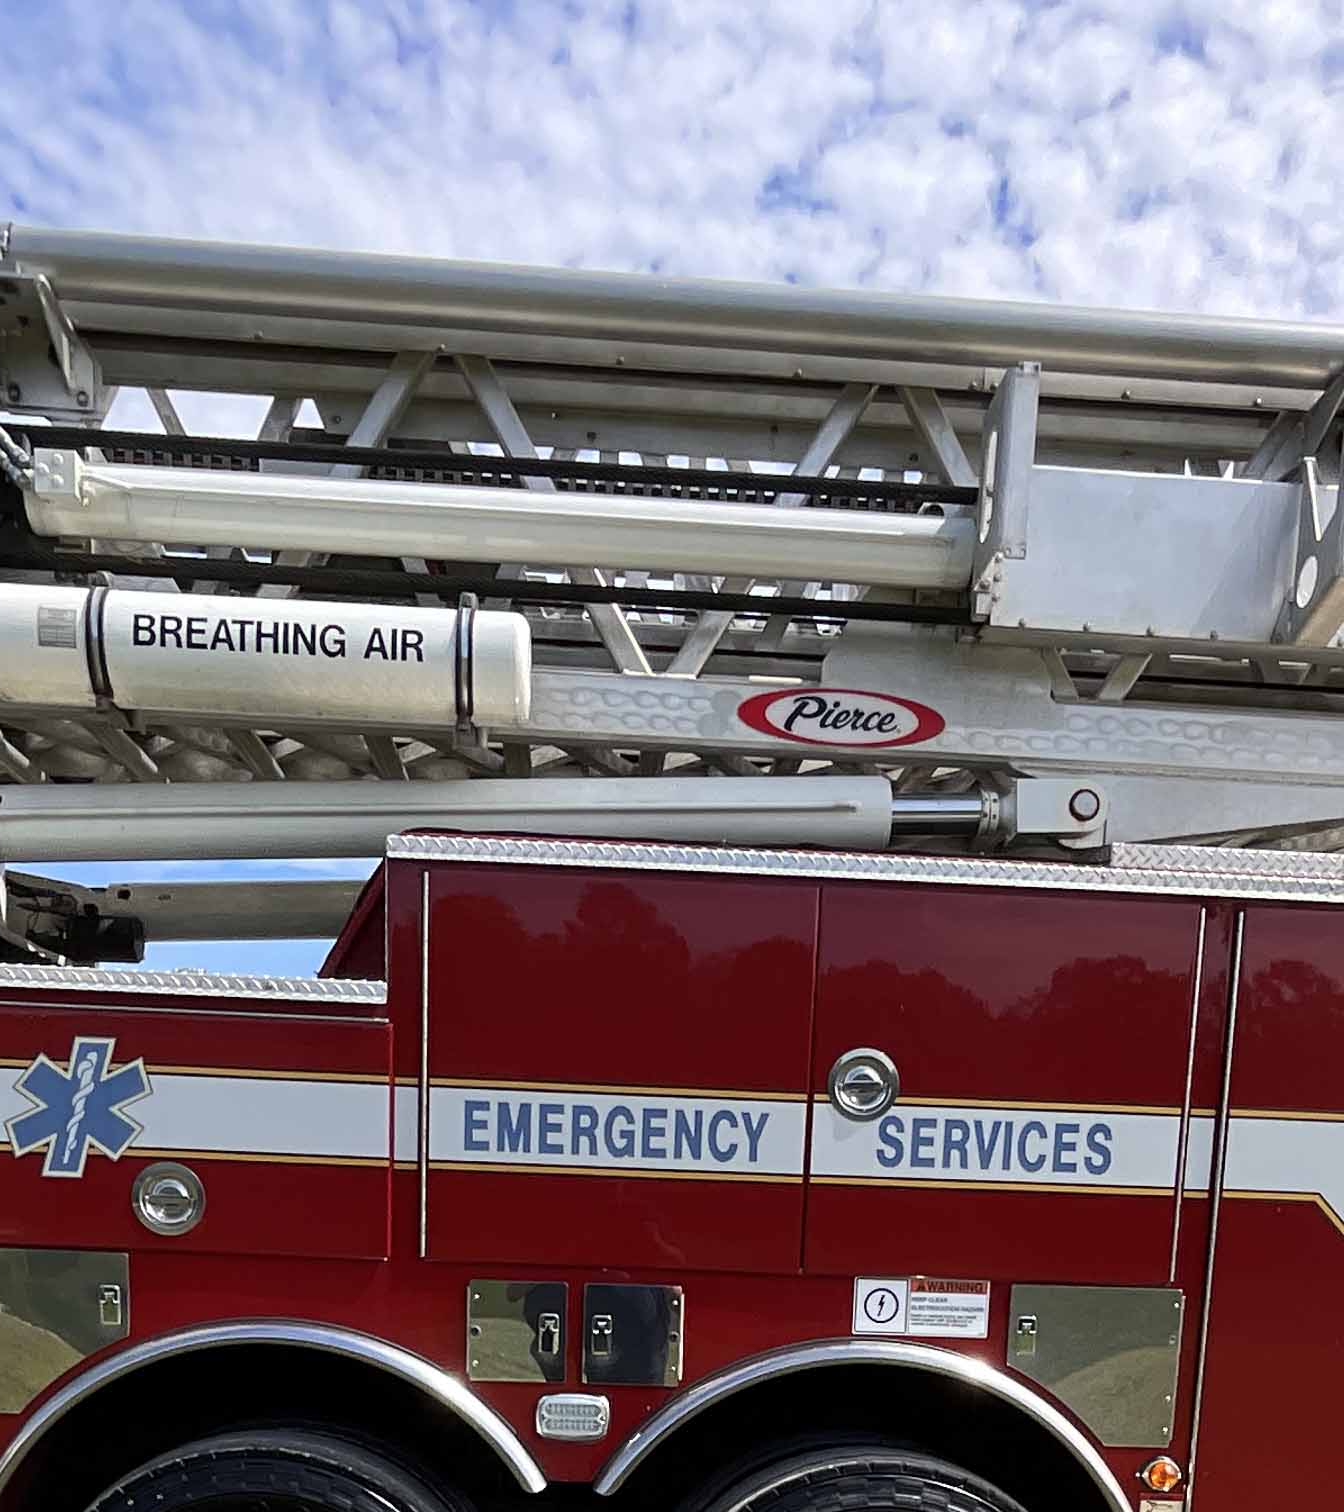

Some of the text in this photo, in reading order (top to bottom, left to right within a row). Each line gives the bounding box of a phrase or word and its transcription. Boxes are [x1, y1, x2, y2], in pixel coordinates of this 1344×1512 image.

[132, 613, 425, 662] BREATHING AIR
[783, 696, 898, 733] Pierce
[463, 1099, 1113, 1175] EMERGENCY SERVICES
[928, 1281, 986, 1293] WARNING
